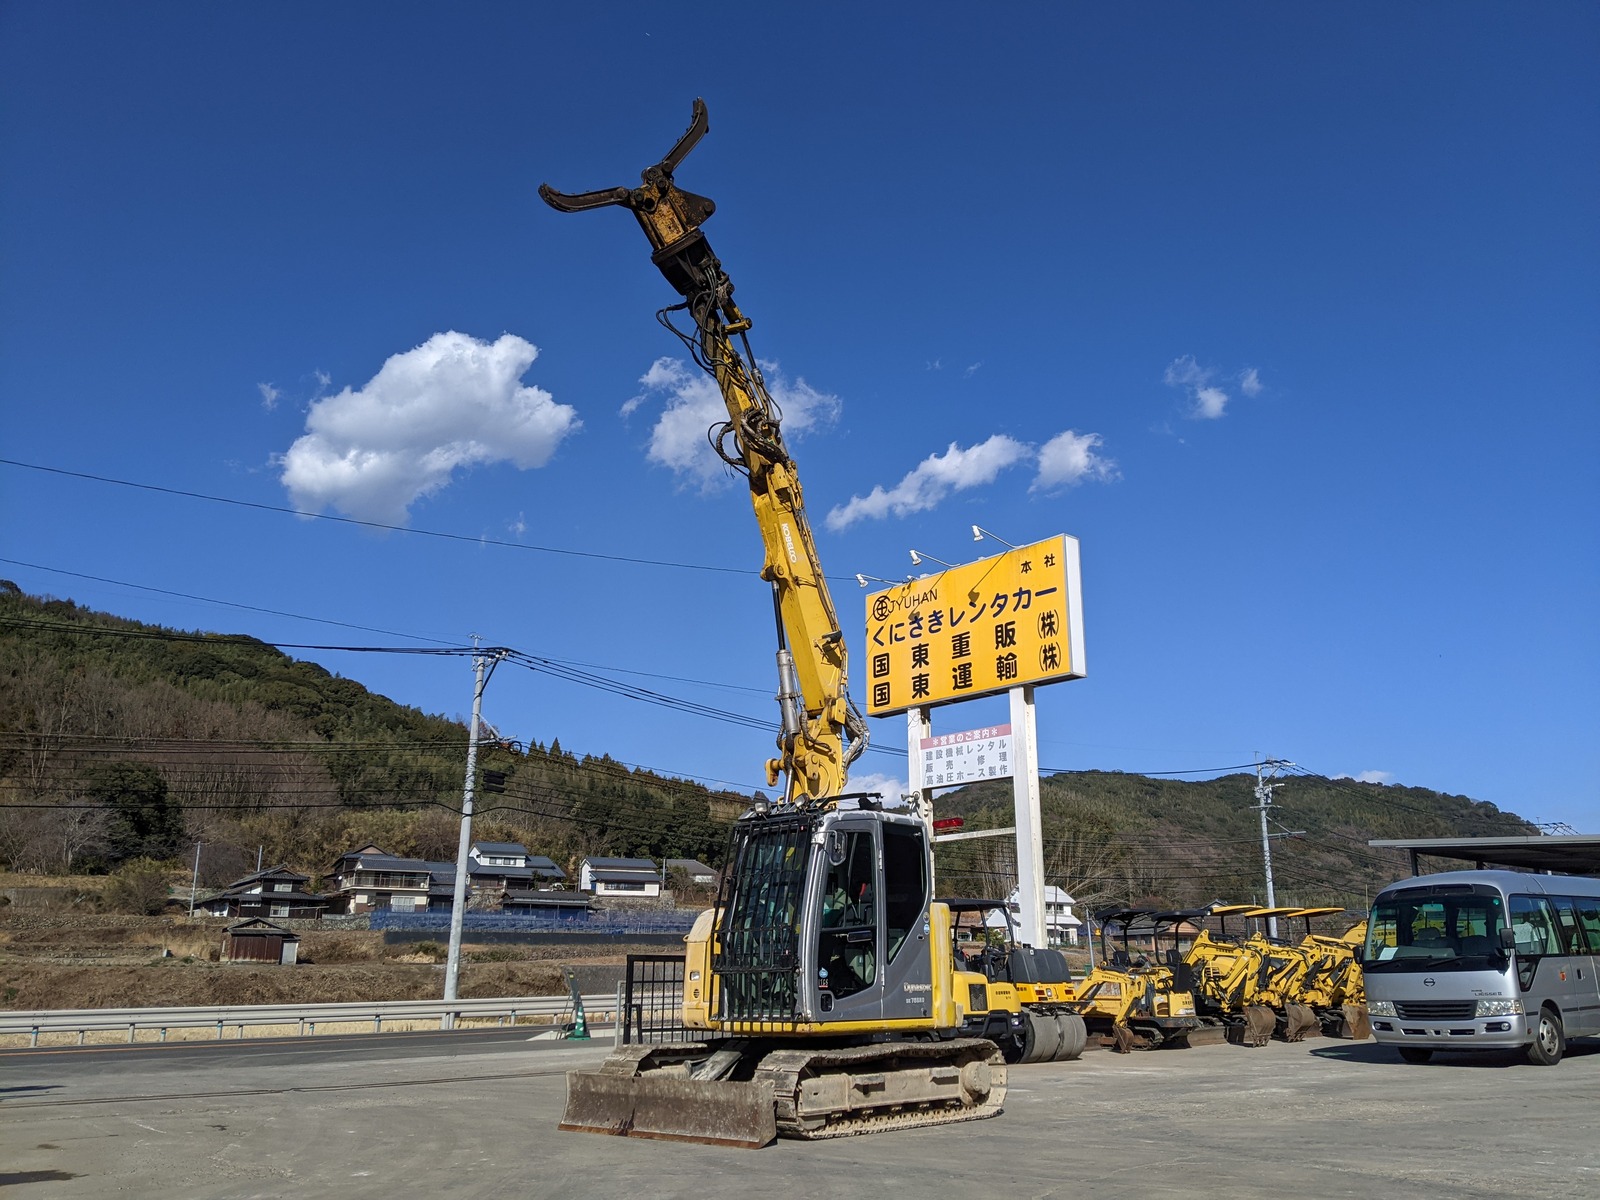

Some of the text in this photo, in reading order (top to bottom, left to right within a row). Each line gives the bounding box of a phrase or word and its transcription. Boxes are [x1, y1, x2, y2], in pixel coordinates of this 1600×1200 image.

[782, 523, 797, 563] KOBELCO
[1021, 553, 1056, 574] 本社
[888, 589, 938, 614] JYUHAN
[873, 587, 1057, 646] くにさきレンタカー
[926, 740, 1006, 761] 建設機械レンタル
[926, 765, 1007, 785] 高油圧ホース製作
